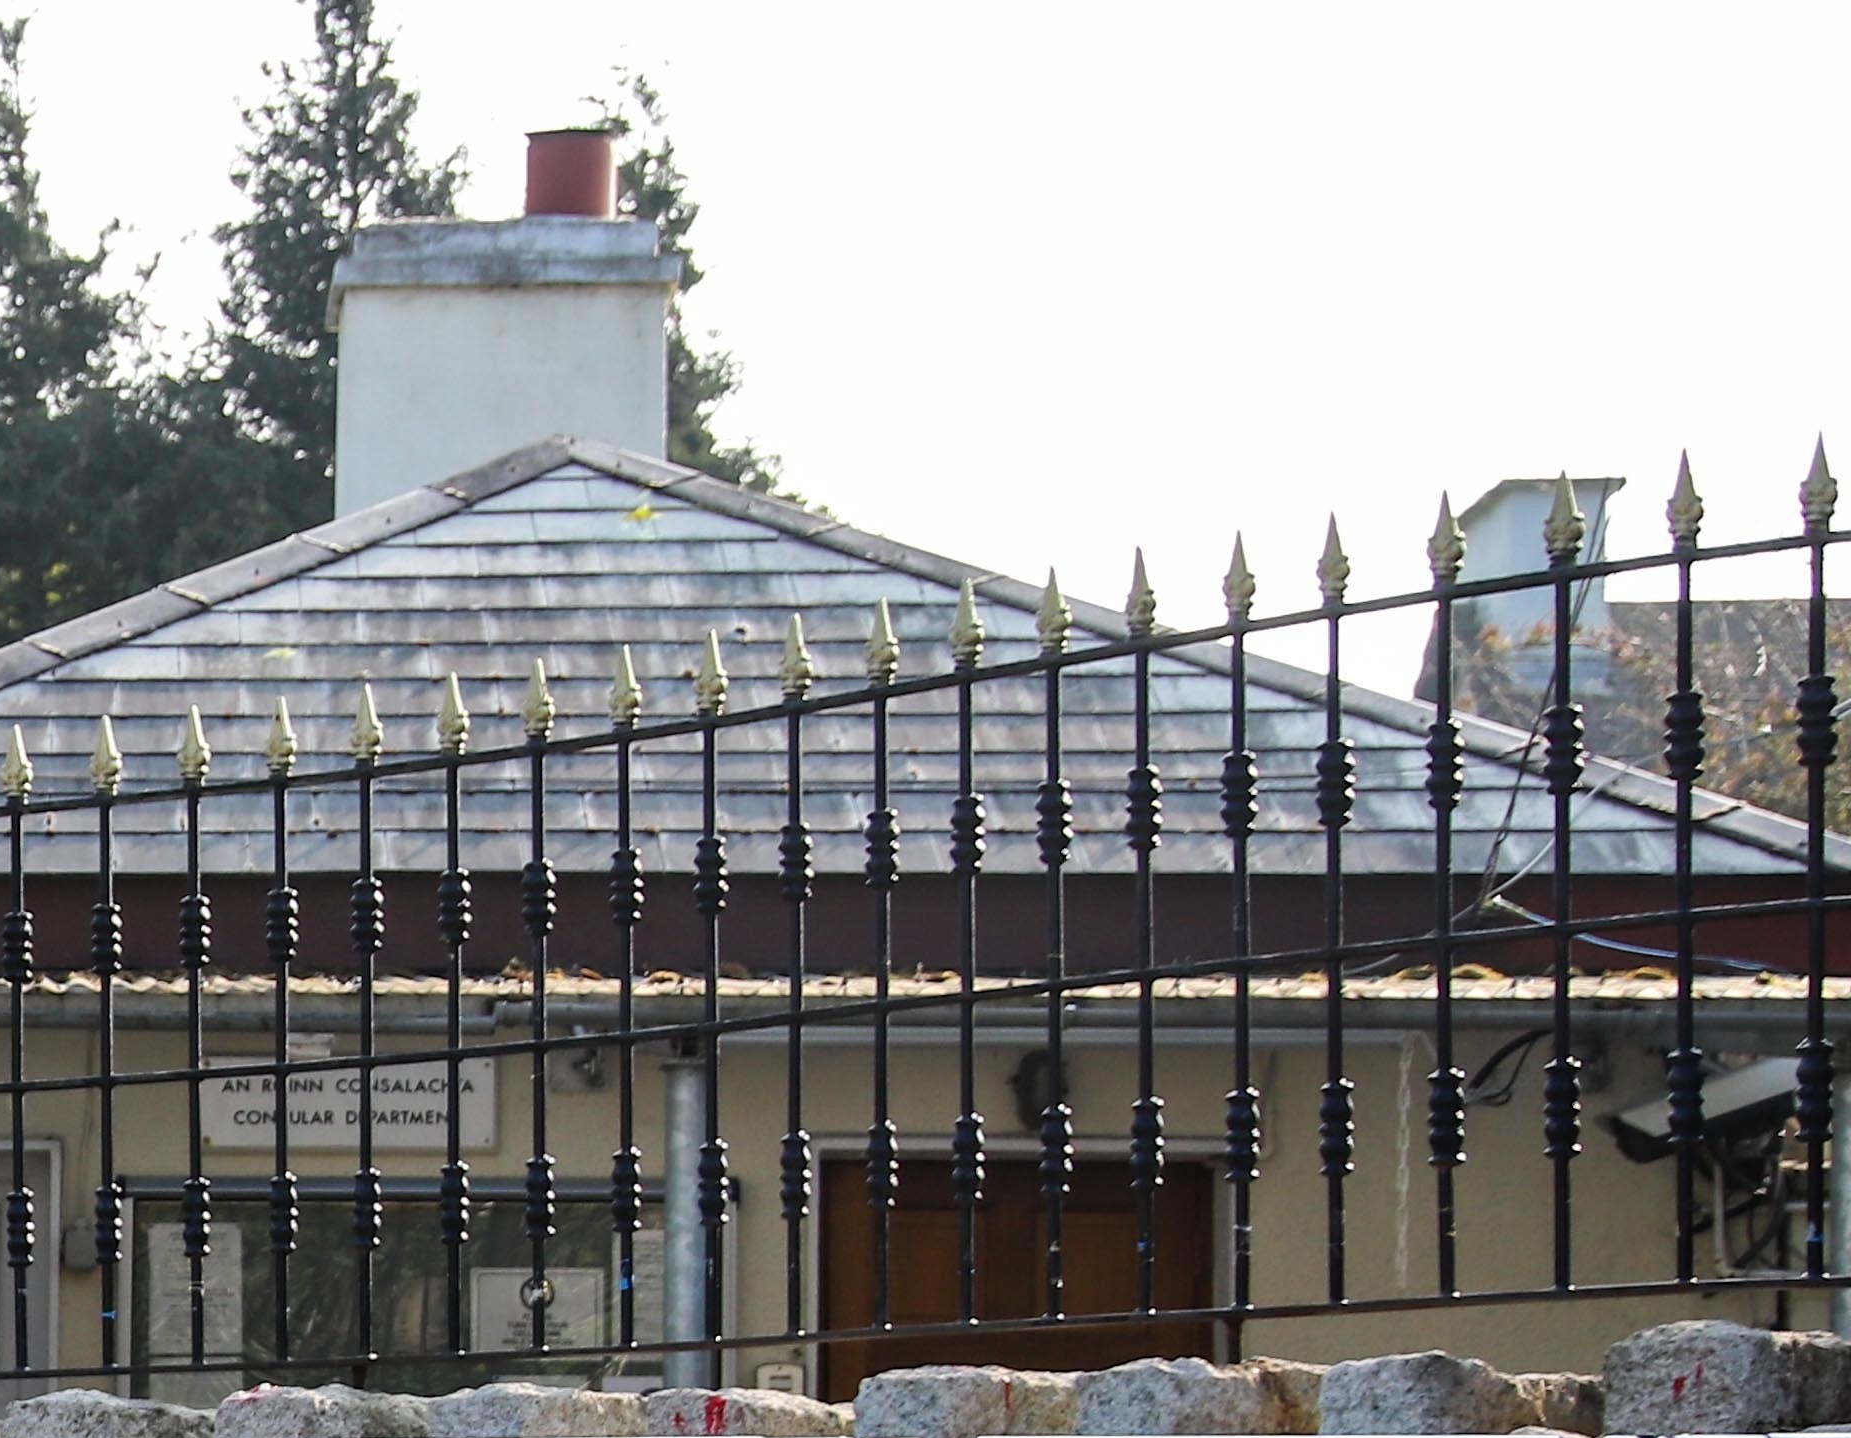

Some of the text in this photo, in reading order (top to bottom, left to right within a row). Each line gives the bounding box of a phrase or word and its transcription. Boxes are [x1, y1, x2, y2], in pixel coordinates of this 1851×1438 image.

[221, 1078, 251, 1093] AN
[261, 1078, 324, 1093] RINN
[232, 1109, 335, 1125] CONULAR
